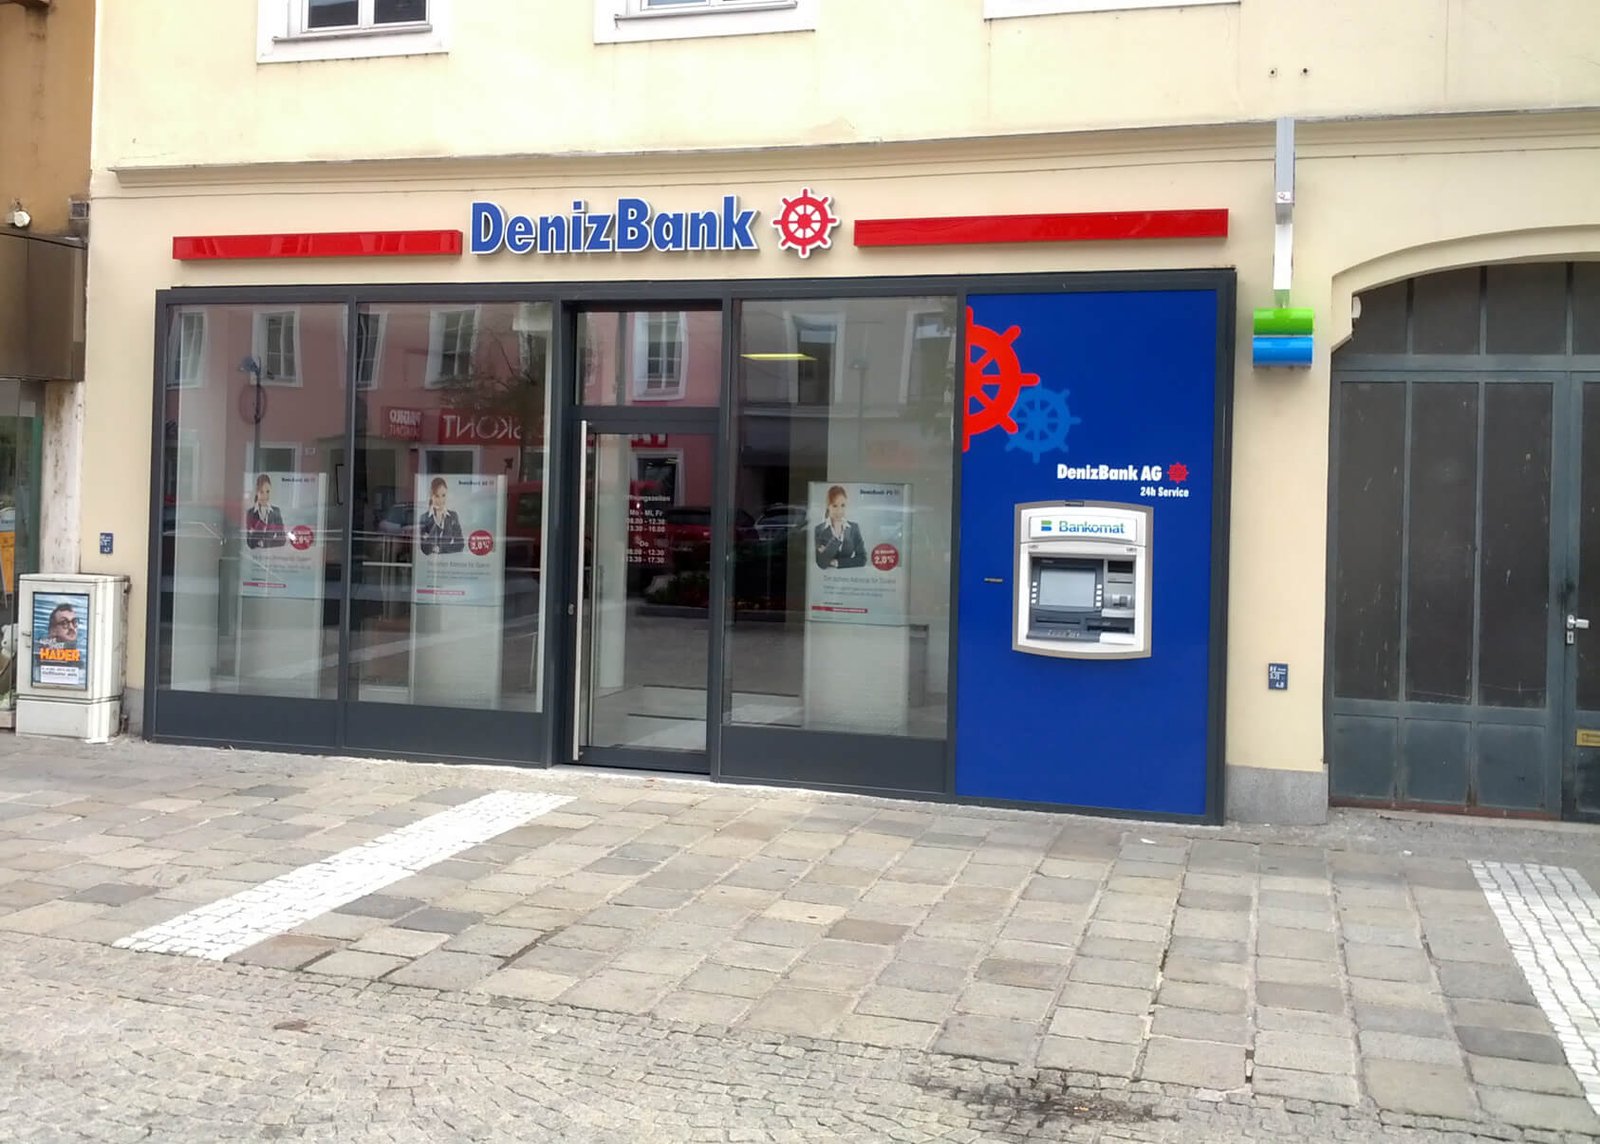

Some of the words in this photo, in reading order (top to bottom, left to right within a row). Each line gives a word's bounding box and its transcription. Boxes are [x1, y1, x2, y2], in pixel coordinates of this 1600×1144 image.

[470, 195, 757, 254] DenizBank
[1057, 463, 1138, 480] DenizBank
[1141, 465, 1162, 481] AG
[1140, 486, 1156, 497] 24h
[1158, 486, 1189, 498] Service
[1059, 520, 1126, 535] Bankomat
[40, 648, 80, 662] HADER
